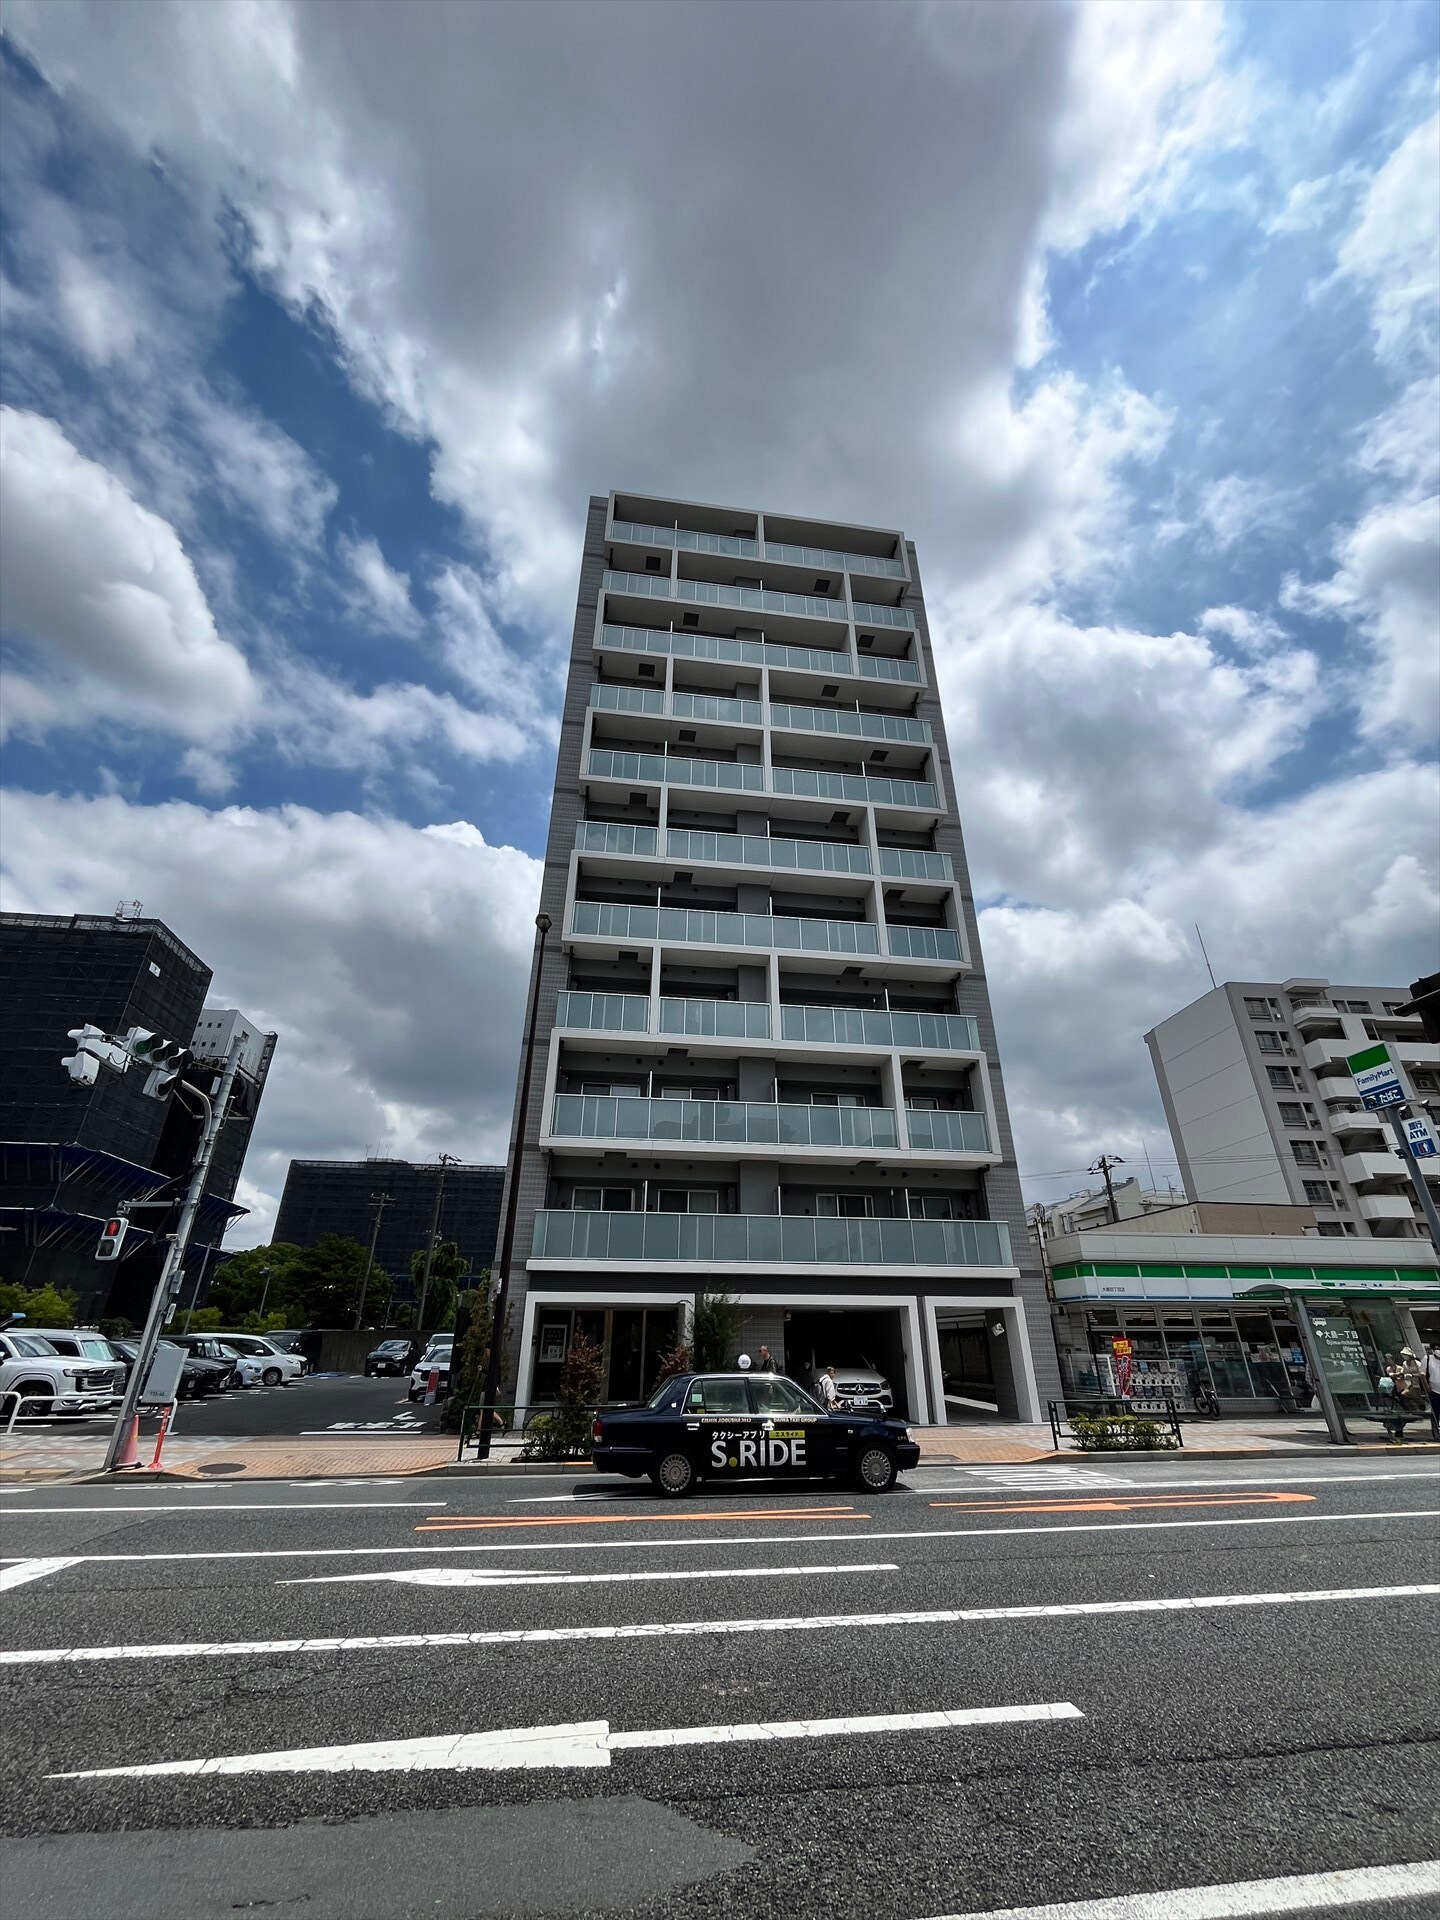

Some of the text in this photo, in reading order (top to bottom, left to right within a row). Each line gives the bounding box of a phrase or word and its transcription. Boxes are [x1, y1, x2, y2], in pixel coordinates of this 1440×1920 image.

[1357, 1068, 1394, 1085] FamilyMart
[1379, 1090, 1401, 1103] たばこ
[1409, 1128, 1428, 1140] ATM
[712, 1430, 765, 1440] タクシーアプリ
[711, 1439, 807, 1468] S.RIDE
